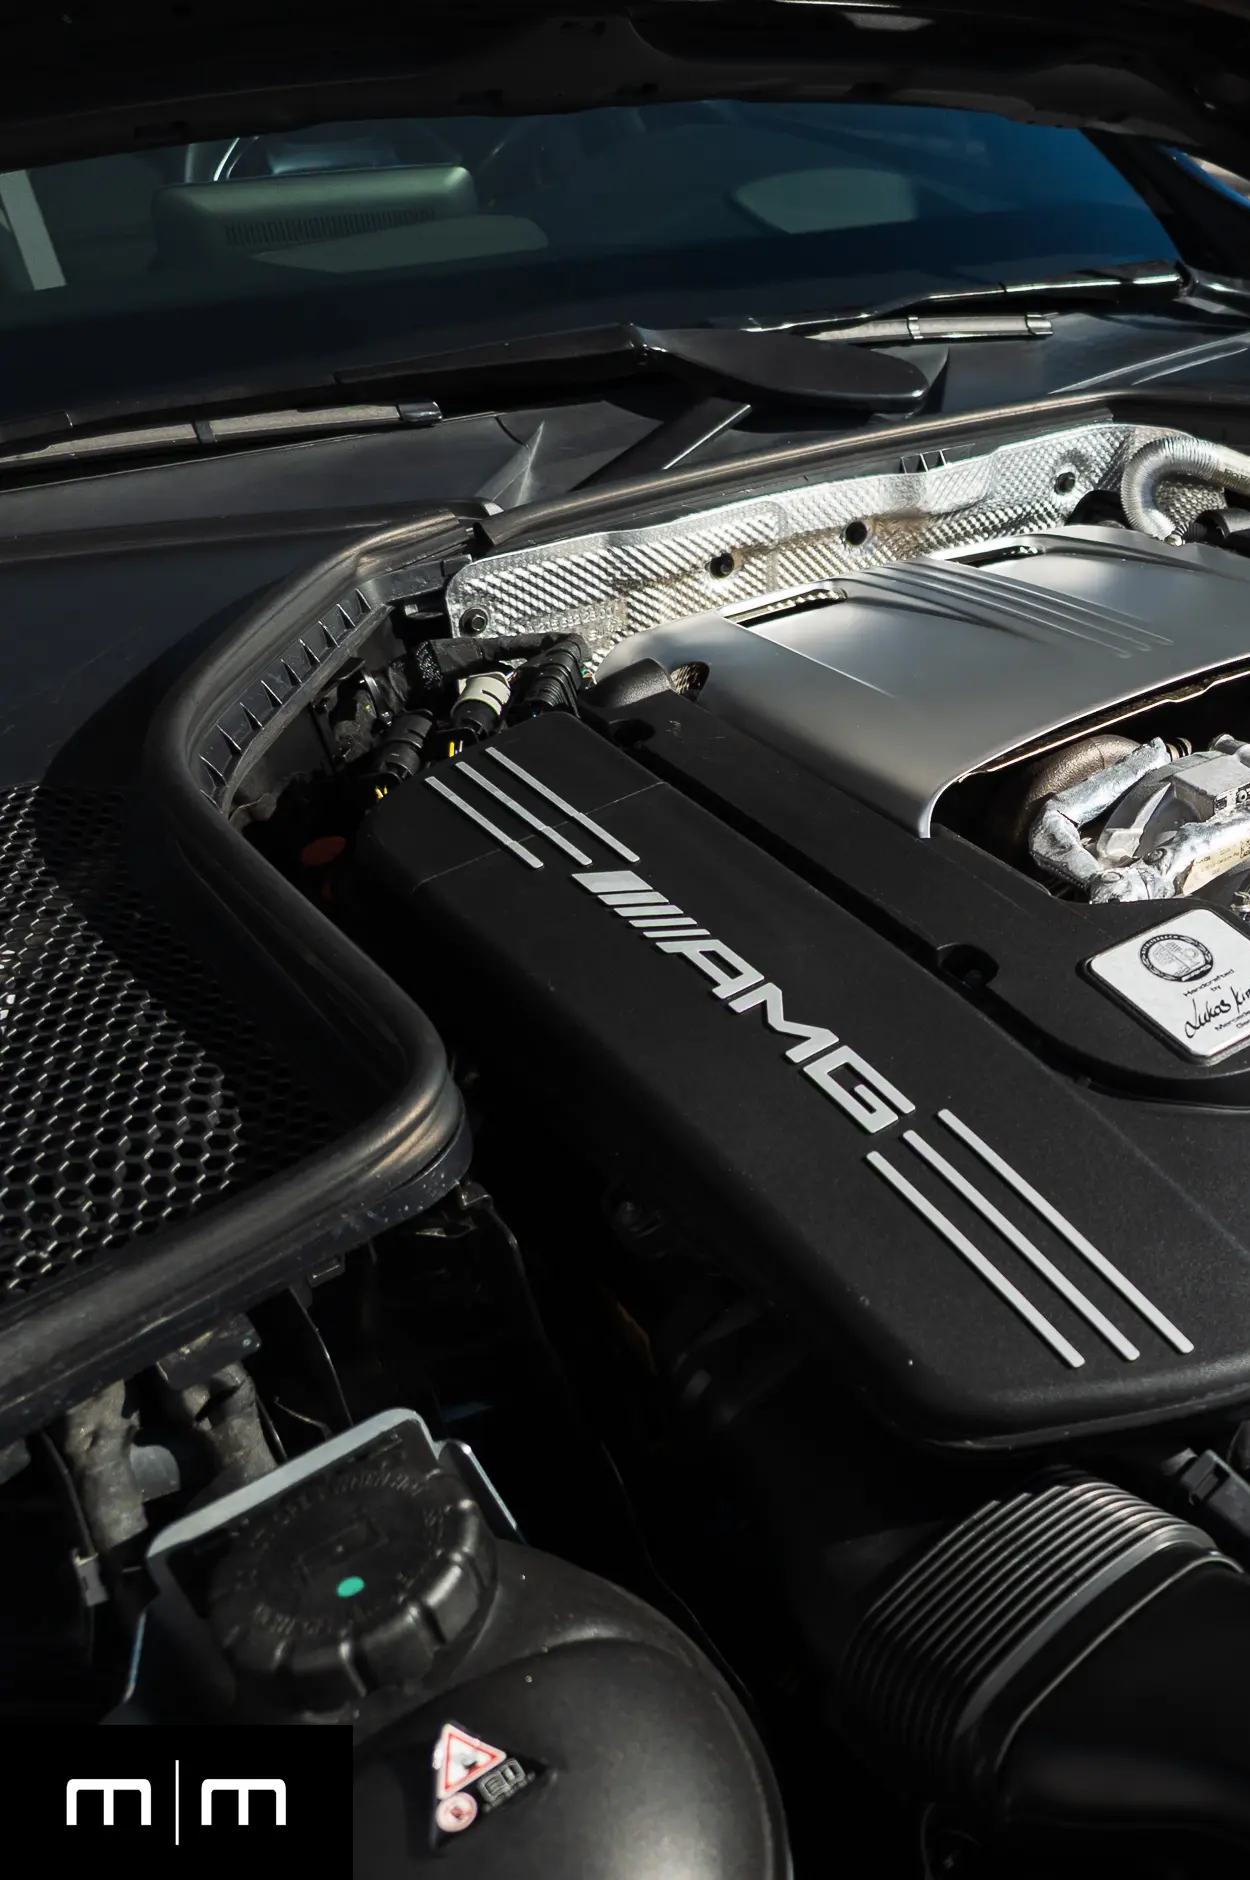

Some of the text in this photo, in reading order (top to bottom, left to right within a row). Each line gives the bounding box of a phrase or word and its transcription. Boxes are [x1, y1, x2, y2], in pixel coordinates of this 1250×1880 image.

[1183, 967, 1236, 997] Handcrafted
[1209, 985, 1222, 993] by
[1184, 997, 1232, 1039] Lukas
[655, 939, 916, 1134] AMG
